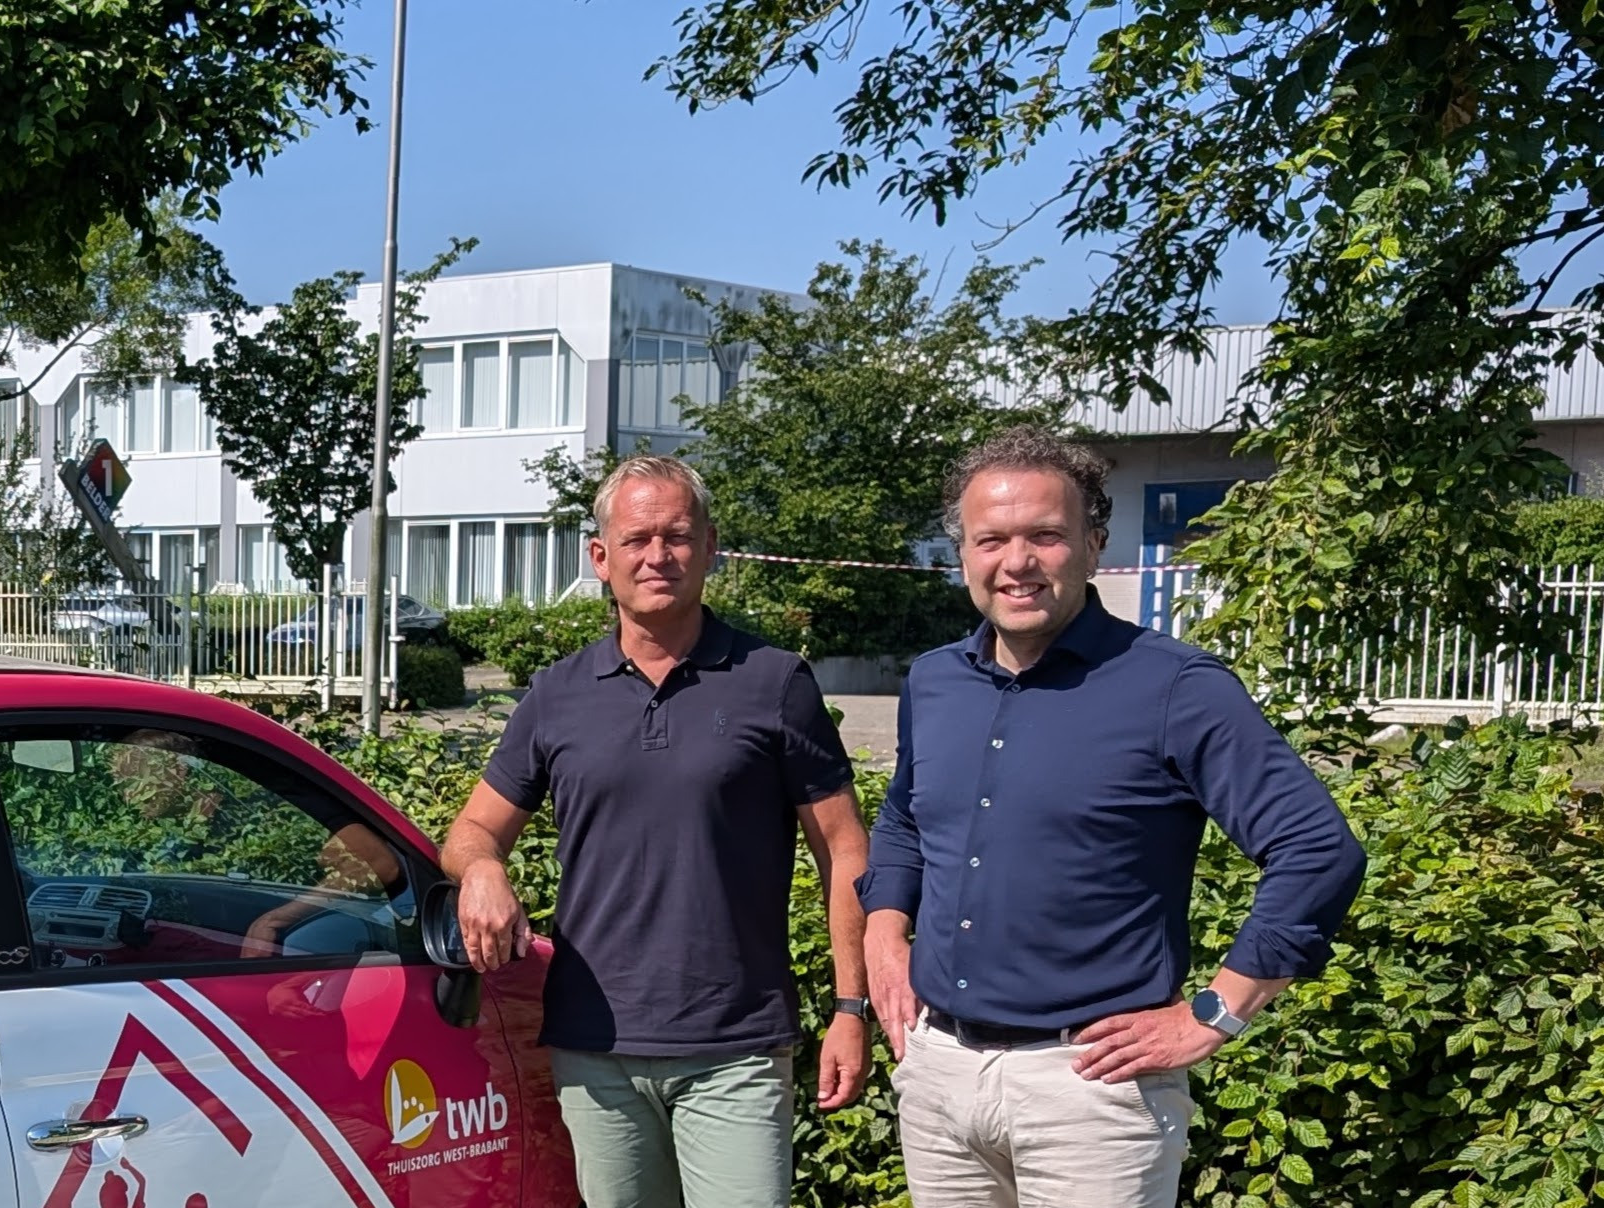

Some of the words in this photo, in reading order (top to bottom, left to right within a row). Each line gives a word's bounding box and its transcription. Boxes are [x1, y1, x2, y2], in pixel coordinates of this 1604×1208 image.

[81, 473, 111, 519] BELDER
[102, 459, 113, 497] 1
[446, 1082, 508, 1140] twb
[387, 1152, 441, 1176] THUISZORG
[443, 1137, 509, 1163] WEST-BRABANT
